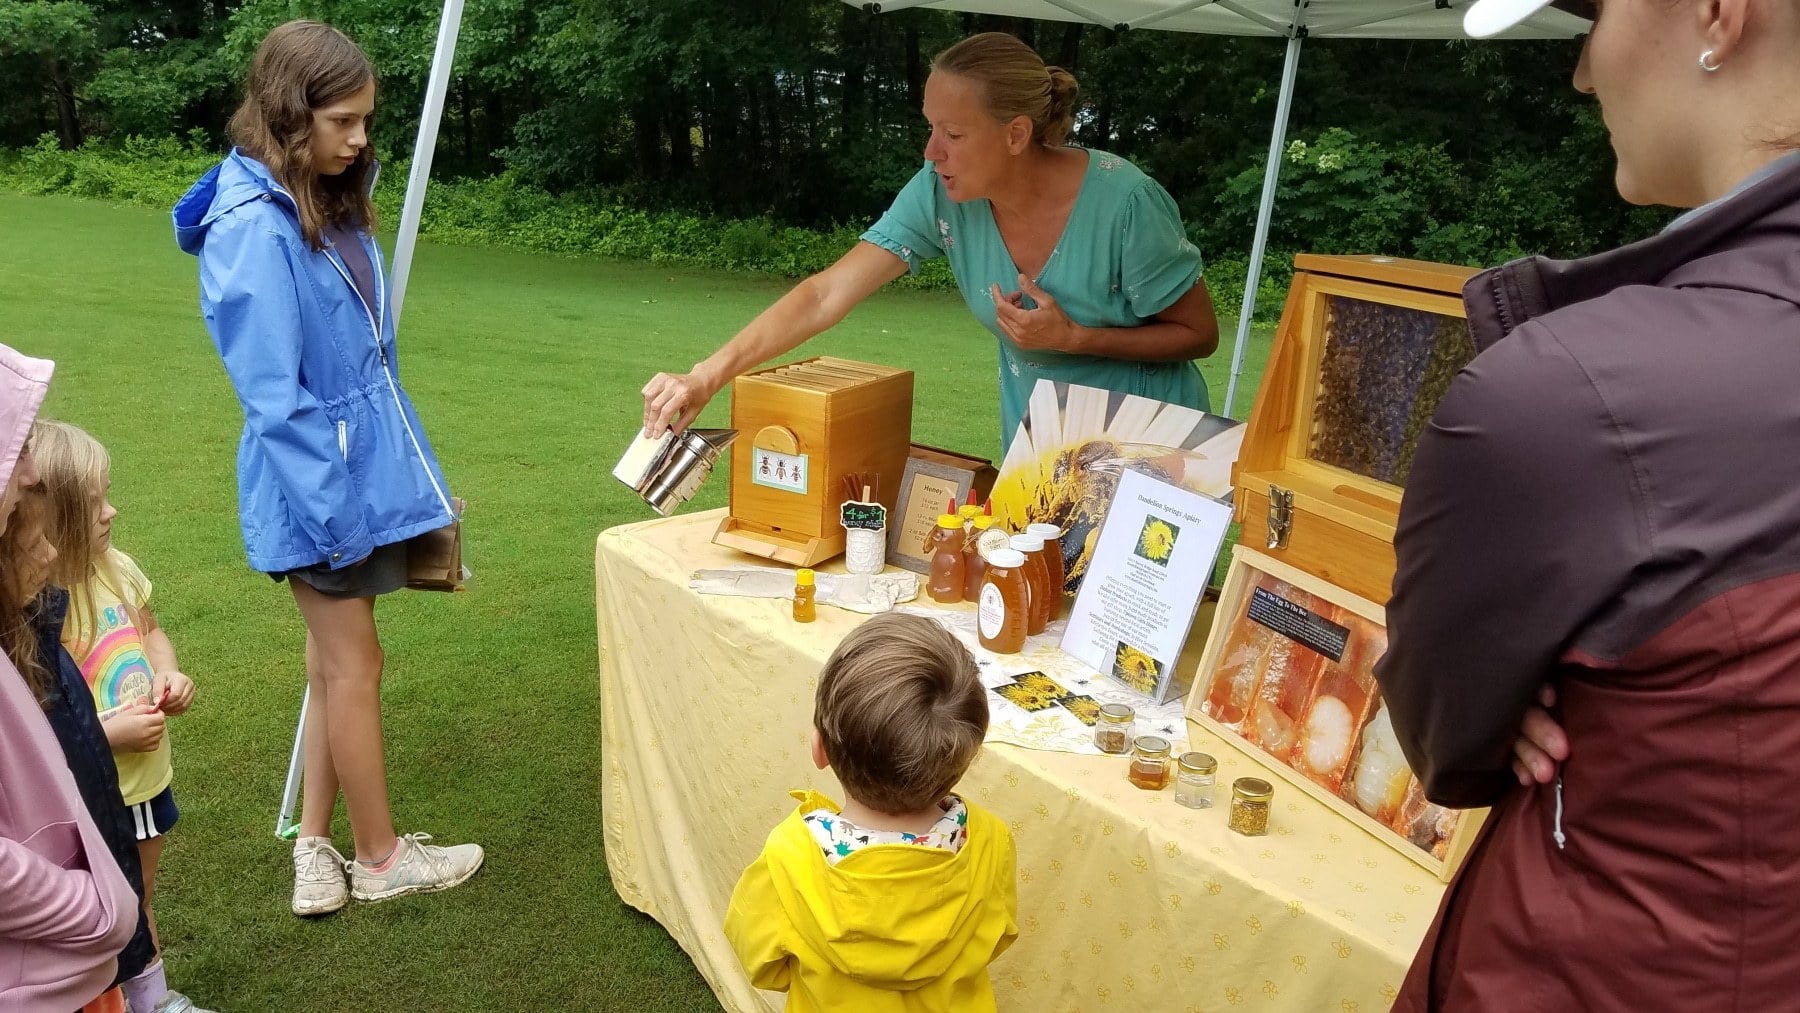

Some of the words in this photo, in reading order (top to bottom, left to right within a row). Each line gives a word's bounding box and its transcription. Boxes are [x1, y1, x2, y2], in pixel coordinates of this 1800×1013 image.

[923, 484, 943, 495] Honey
[846, 507, 857, 520] 4
[857, 510, 870, 520] for
[871, 506, 884, 522] $1
[1138, 494, 1163, 510] Dandelion
[1162, 504, 1182, 517] Springs
[1182, 512, 1202, 526] Apiary
[843, 518, 864, 528] honey
[1256, 588, 1267, 598] From
[1290, 604, 1298, 613] The
[1298, 608, 1307, 617] Bee
[122, 674, 144, 694] make
